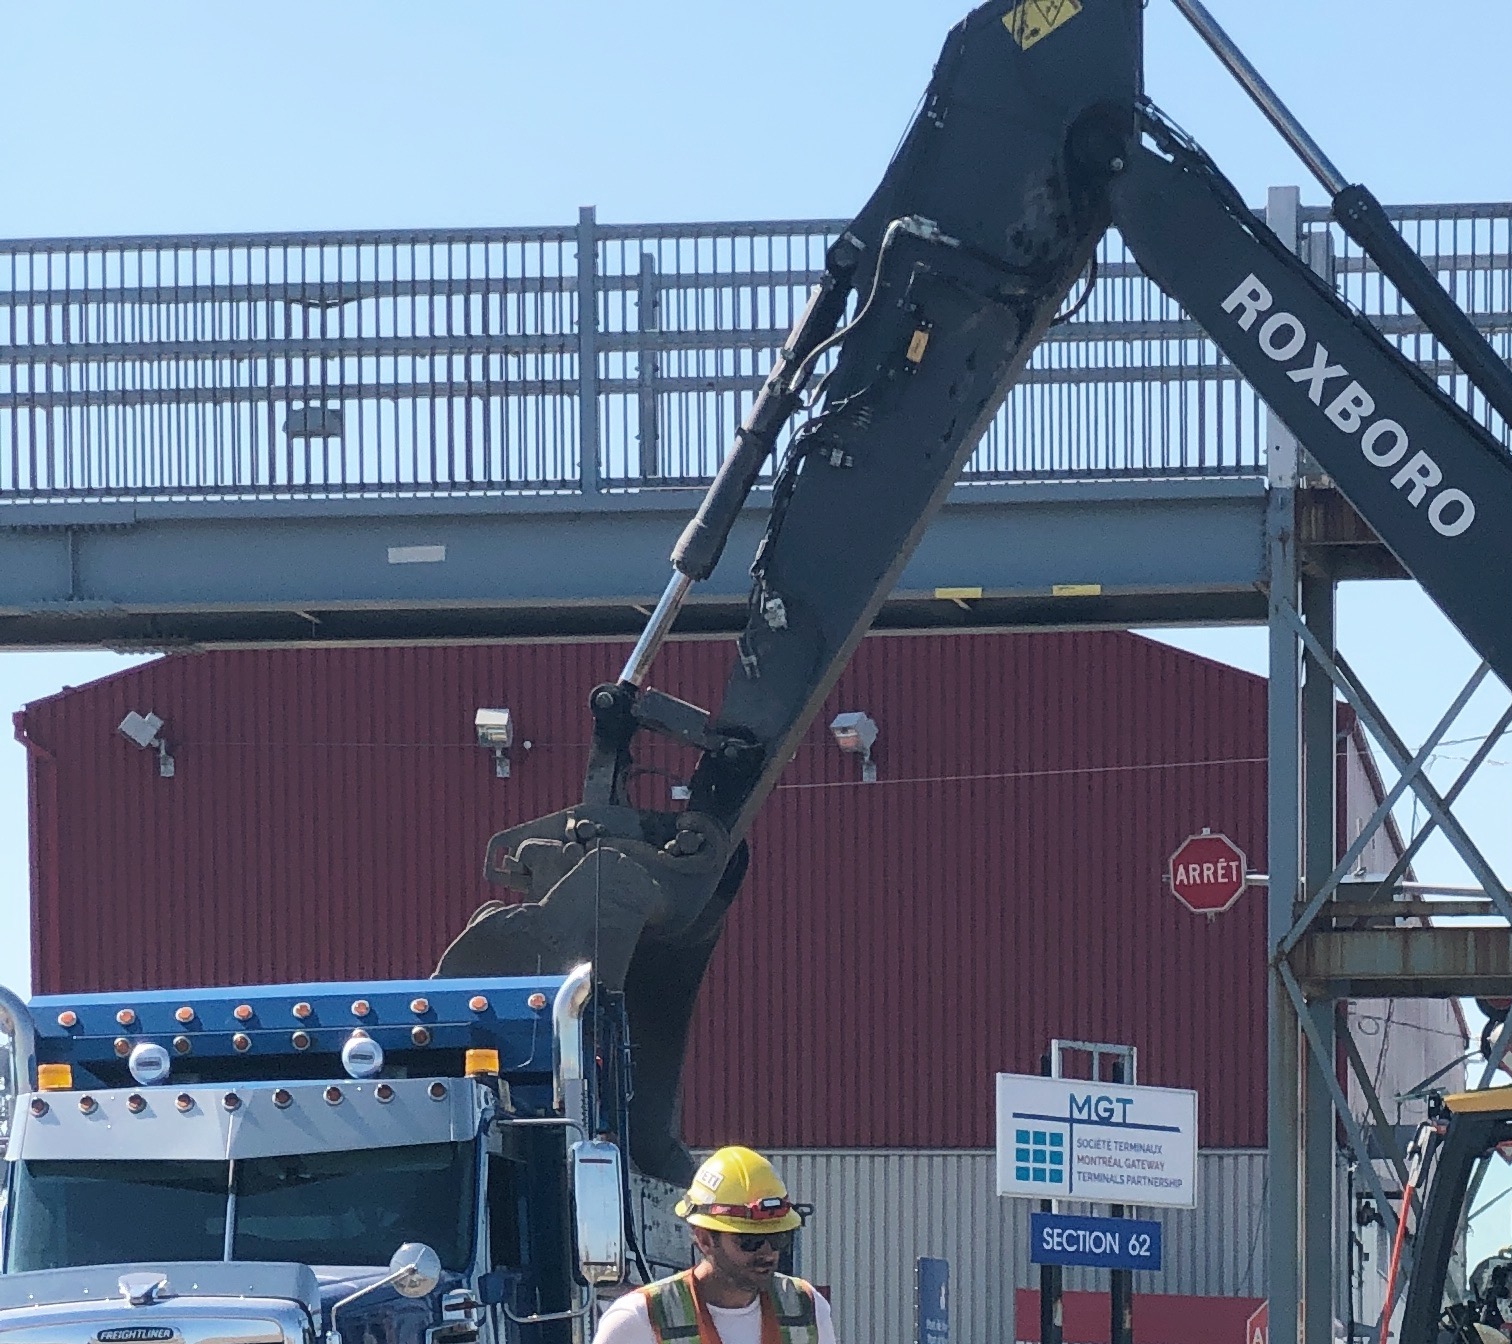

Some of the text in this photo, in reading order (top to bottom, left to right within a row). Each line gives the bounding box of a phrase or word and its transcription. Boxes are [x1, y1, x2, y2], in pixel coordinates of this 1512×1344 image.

[1221, 272, 1476, 537] ROXBORO
[1175, 858, 1239, 885] ARRÊT
[1069, 1093, 1134, 1124] MGT
[1114, 1141, 1163, 1154] TERMINAUX
[1077, 1155, 1165, 1171] MONTRÉAL GATEWAY
[1077, 1171, 1183, 1188] TERMINALS PARTNERSHIP
[1042, 1227, 1151, 1256] SECTION 62
[100, 1329, 171, 1340] FREIGHTLINER
